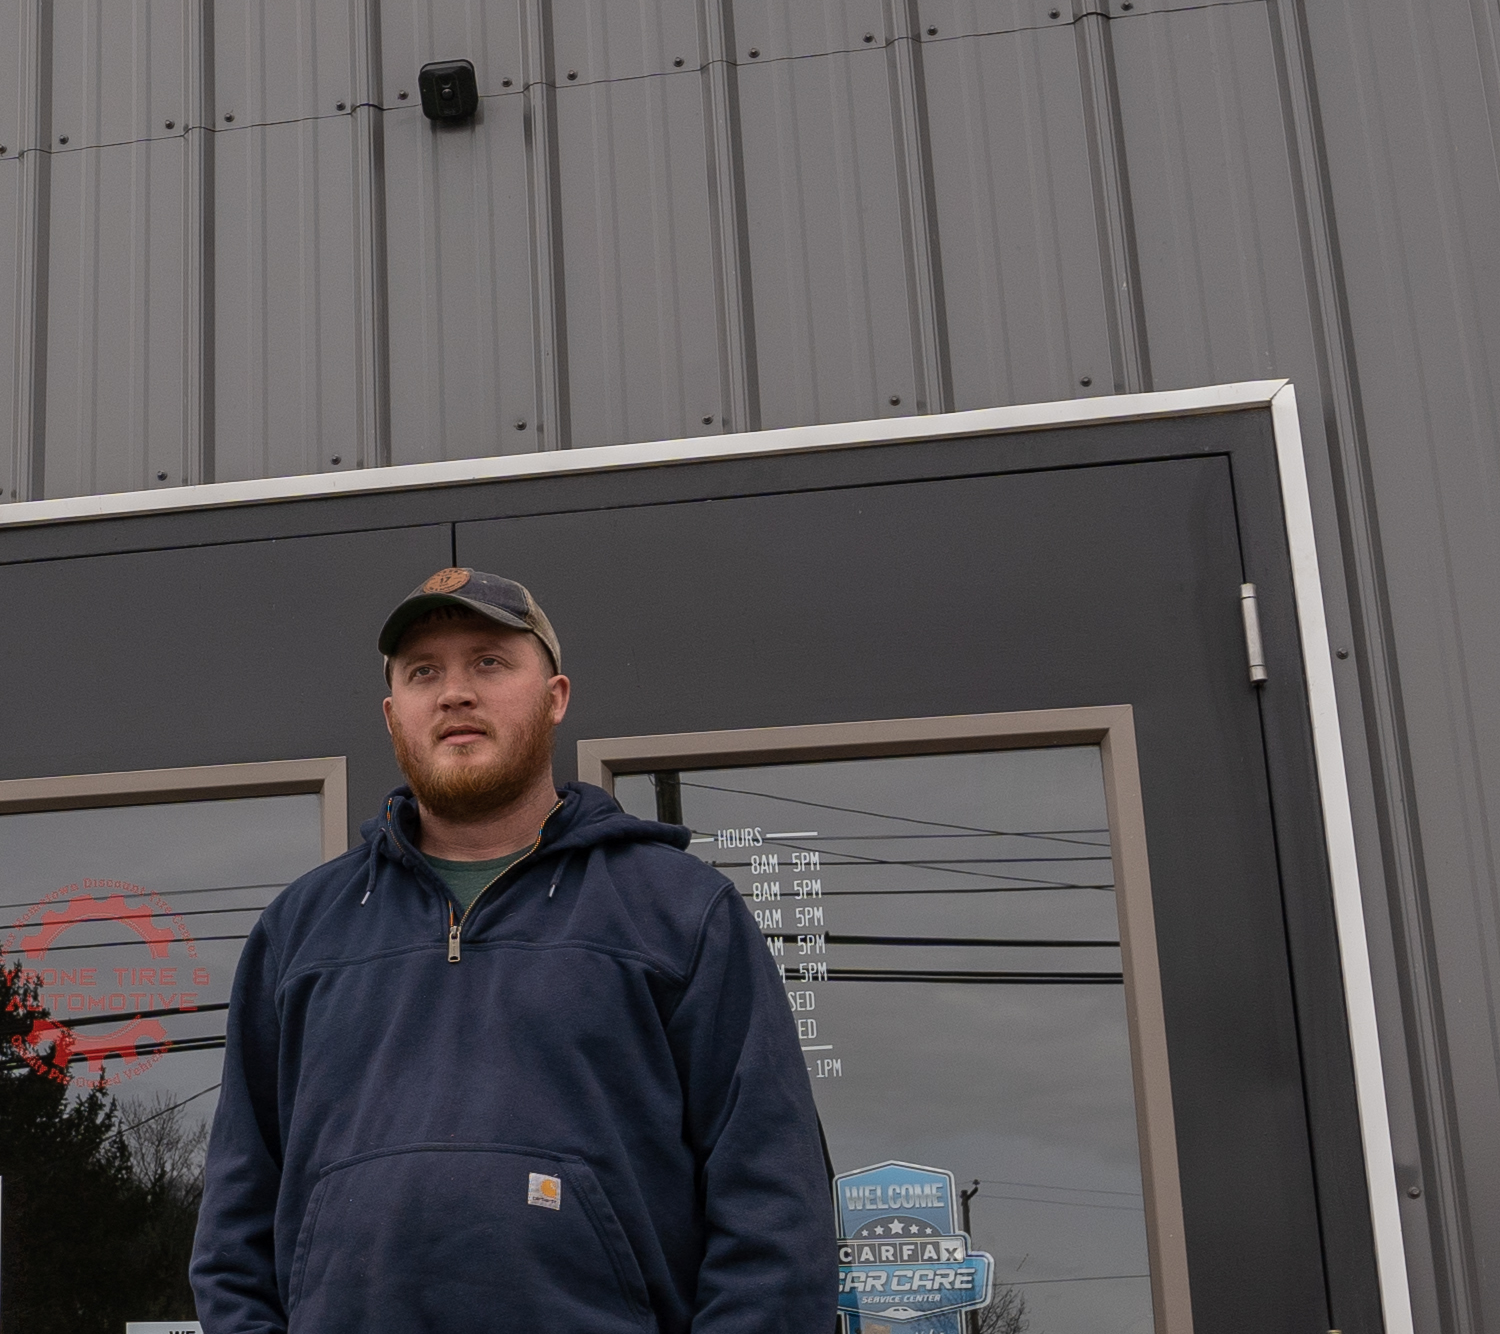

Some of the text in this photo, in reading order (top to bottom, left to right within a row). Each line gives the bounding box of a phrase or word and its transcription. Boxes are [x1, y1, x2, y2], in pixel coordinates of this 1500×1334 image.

[717, 827, 763, 849] HOURS
[751, 852, 820, 874] 8AM 5PM
[753, 879, 822, 902] 8AM 5PM
[83, 877, 146, 896] Discount
[149, 889, 173, 915] Tire
[172, 914, 198, 959] Center
[754, 907, 824, 929] 8AM 5PM
[767, 934, 826, 956] AM 5PM
[113, 967, 178, 987] TIRE
[799, 962, 828, 983] 5PM
[5, 993, 198, 1012] AUTOMOTIVE
[845, 1182, 945, 1211] WELCOME
[839, 1243, 960, 1263] CARFAX
[891, 1268, 976, 1291] CARE
[861, 1294, 941, 1304] SERVICE CENTER
